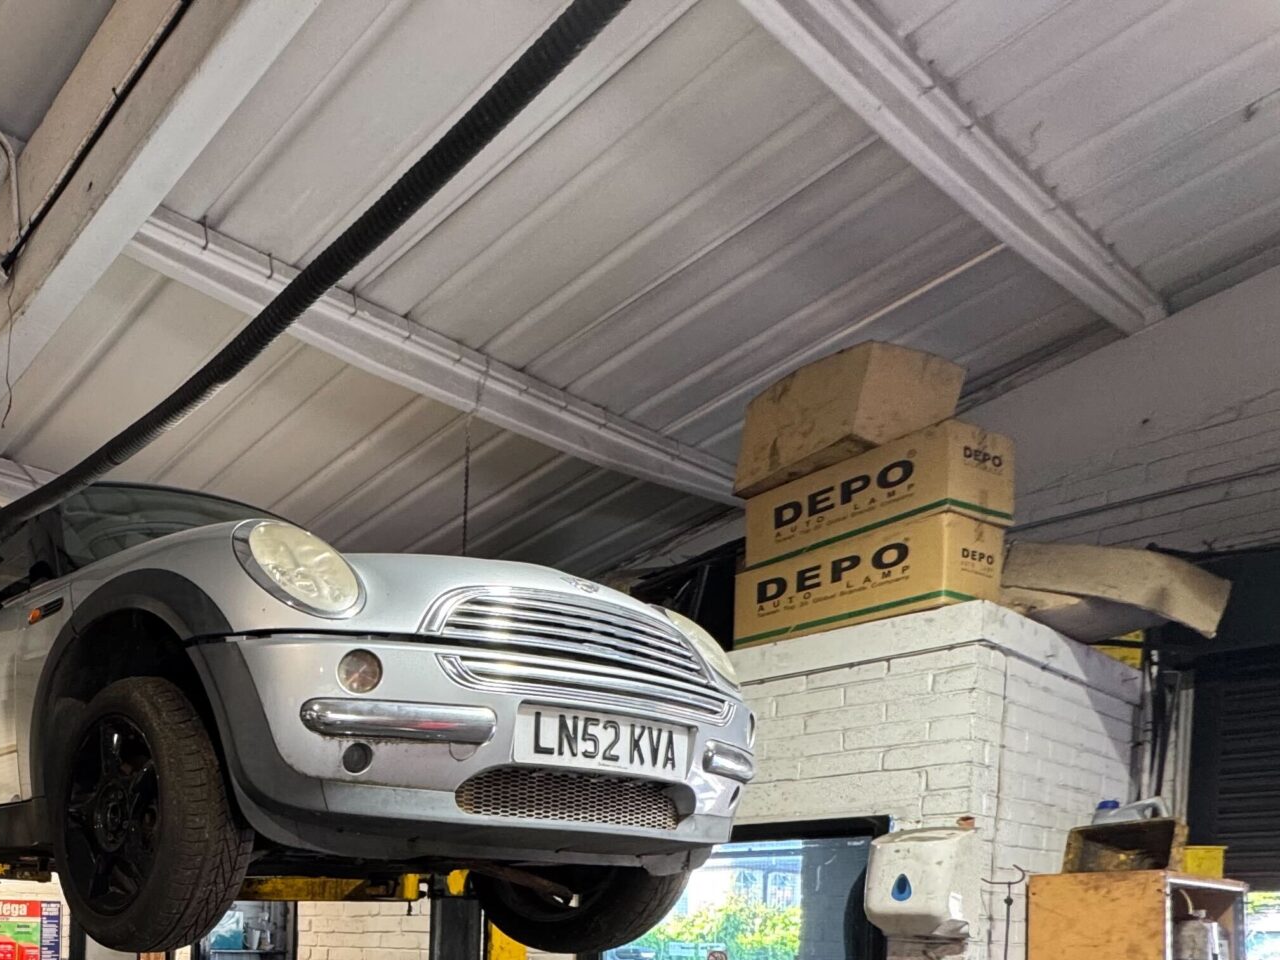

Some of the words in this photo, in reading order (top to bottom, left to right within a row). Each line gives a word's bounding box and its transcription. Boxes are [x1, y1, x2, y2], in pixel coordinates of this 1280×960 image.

[963, 446, 1002, 467] DEPO
[774, 460, 914, 530] DEPO
[775, 516, 825, 538] AUTO
[853, 483, 915, 510] LAMP
[756, 542, 909, 604] DEPO
[961, 548, 994, 565] DEPO
[757, 591, 812, 612] AUTO
[846, 565, 910, 588] LAMP
[533, 711, 621, 762] LN52
[629, 723, 676, 771] KVA
